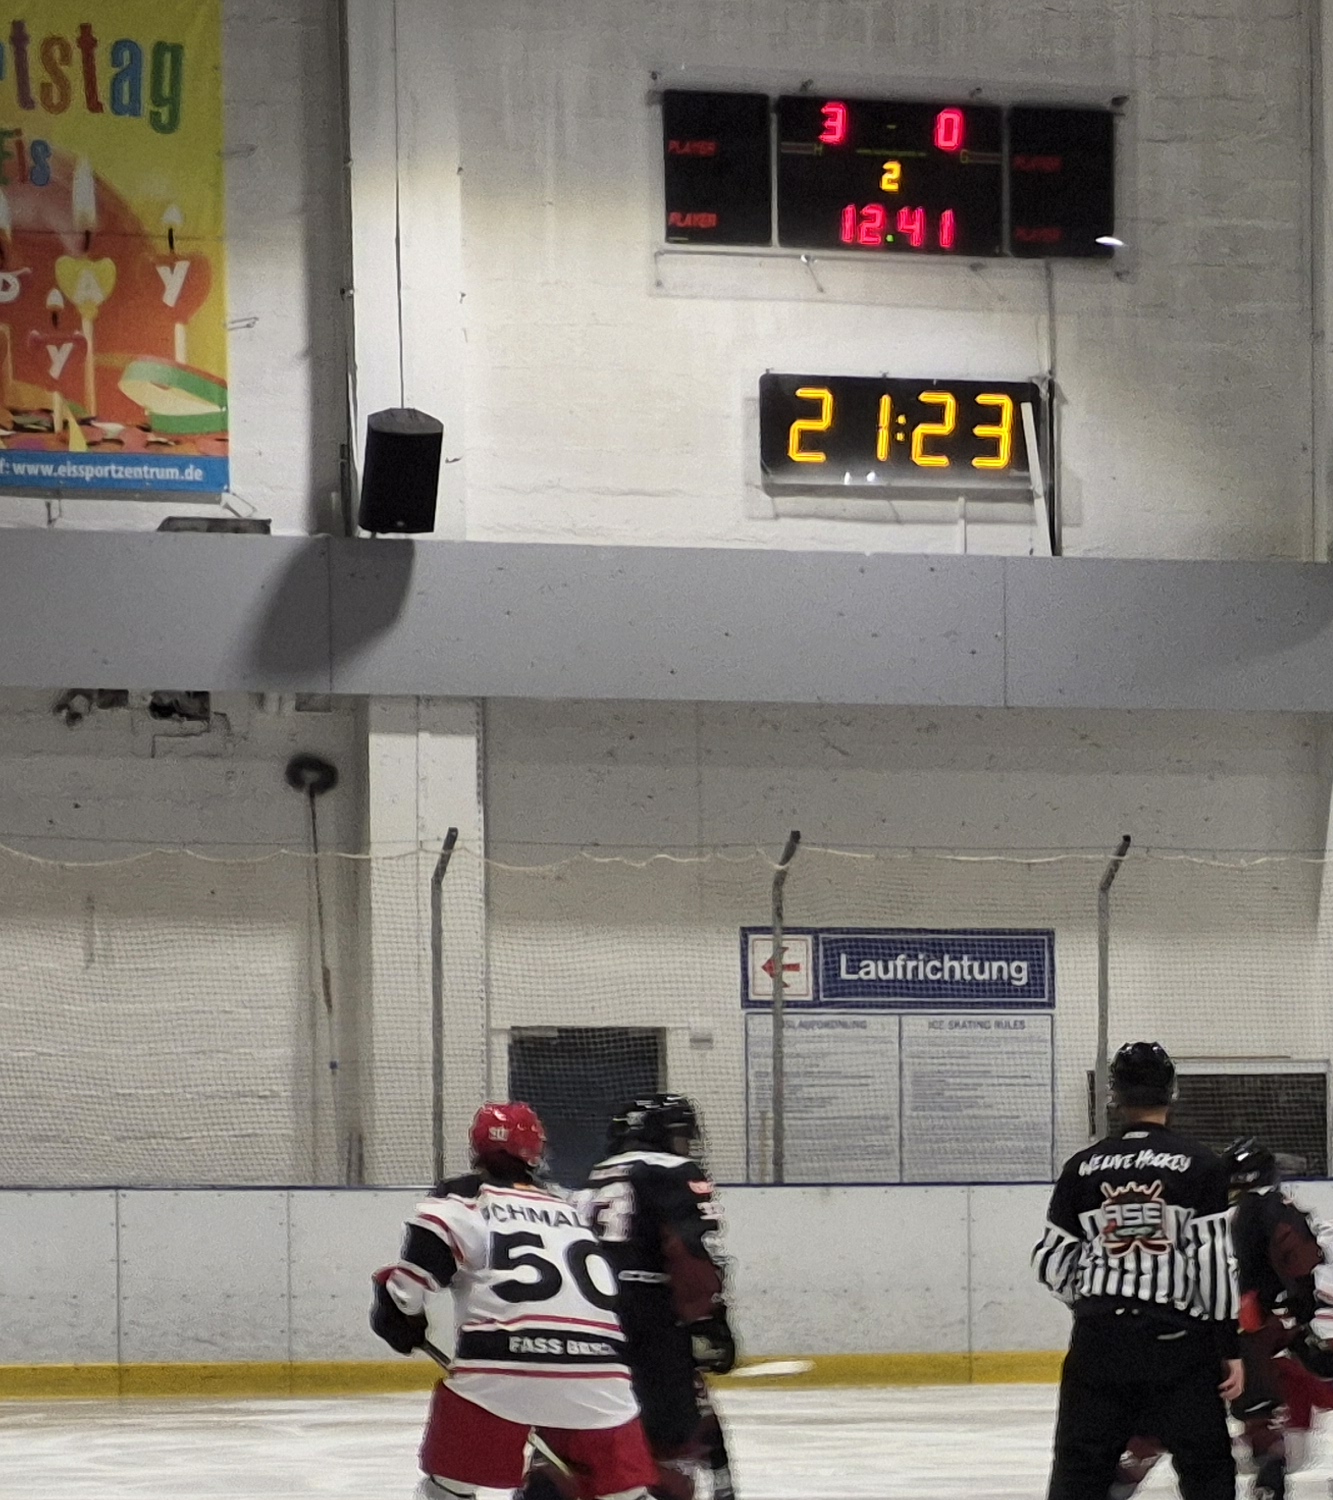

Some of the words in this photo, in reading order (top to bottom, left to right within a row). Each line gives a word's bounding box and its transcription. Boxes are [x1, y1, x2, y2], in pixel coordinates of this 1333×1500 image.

[0, 19, 184, 134] tstag
[818, 101, 848, 145] 3
[934, 108, 966, 151] 0
[880, 160, 902, 193] 2
[787, 387, 1016, 470] 21:23
[12, 459, 204, 482] www.eissportzentrum.de
[838, 953, 1029, 986] Laufrichtung
[488, 1230, 622, 1313] 50
[508, 1335, 564, 1356] FASS
